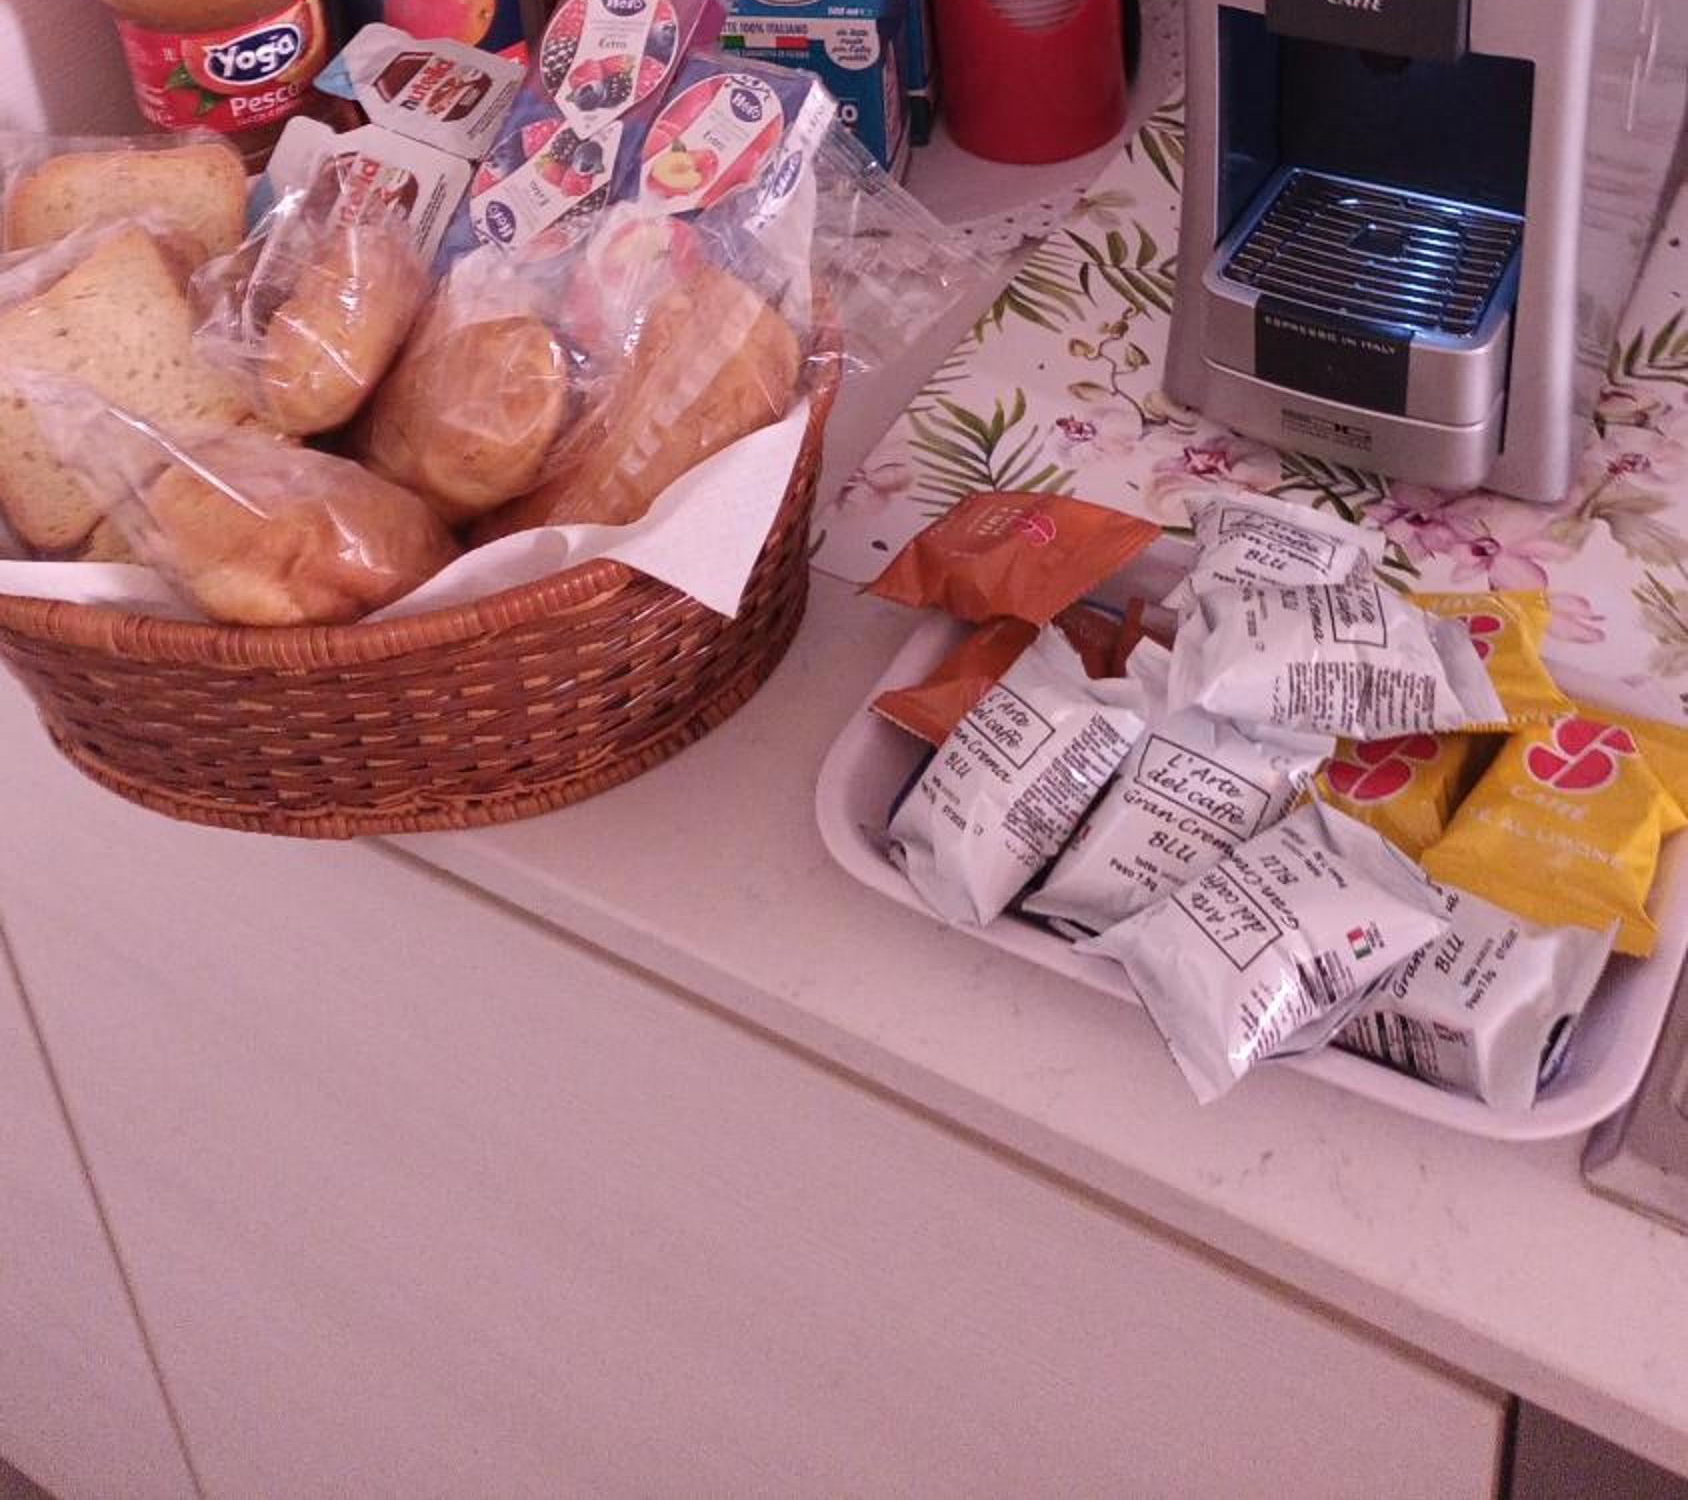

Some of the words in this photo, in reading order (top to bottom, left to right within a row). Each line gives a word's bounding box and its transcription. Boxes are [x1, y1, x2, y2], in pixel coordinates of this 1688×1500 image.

[216, 34, 295, 77] Yoga
[400, 58, 454, 111] nutella
[1122, 789, 1176, 824] Gran
[1147, 767, 1189, 794] del
[1187, 789, 1246, 826] caffè
[1148, 831, 1198, 864] BLU
[1260, 854, 1299, 885] BLU
[1392, 948, 1426, 999] Gran
[1434, 933, 1465, 975] BLU
